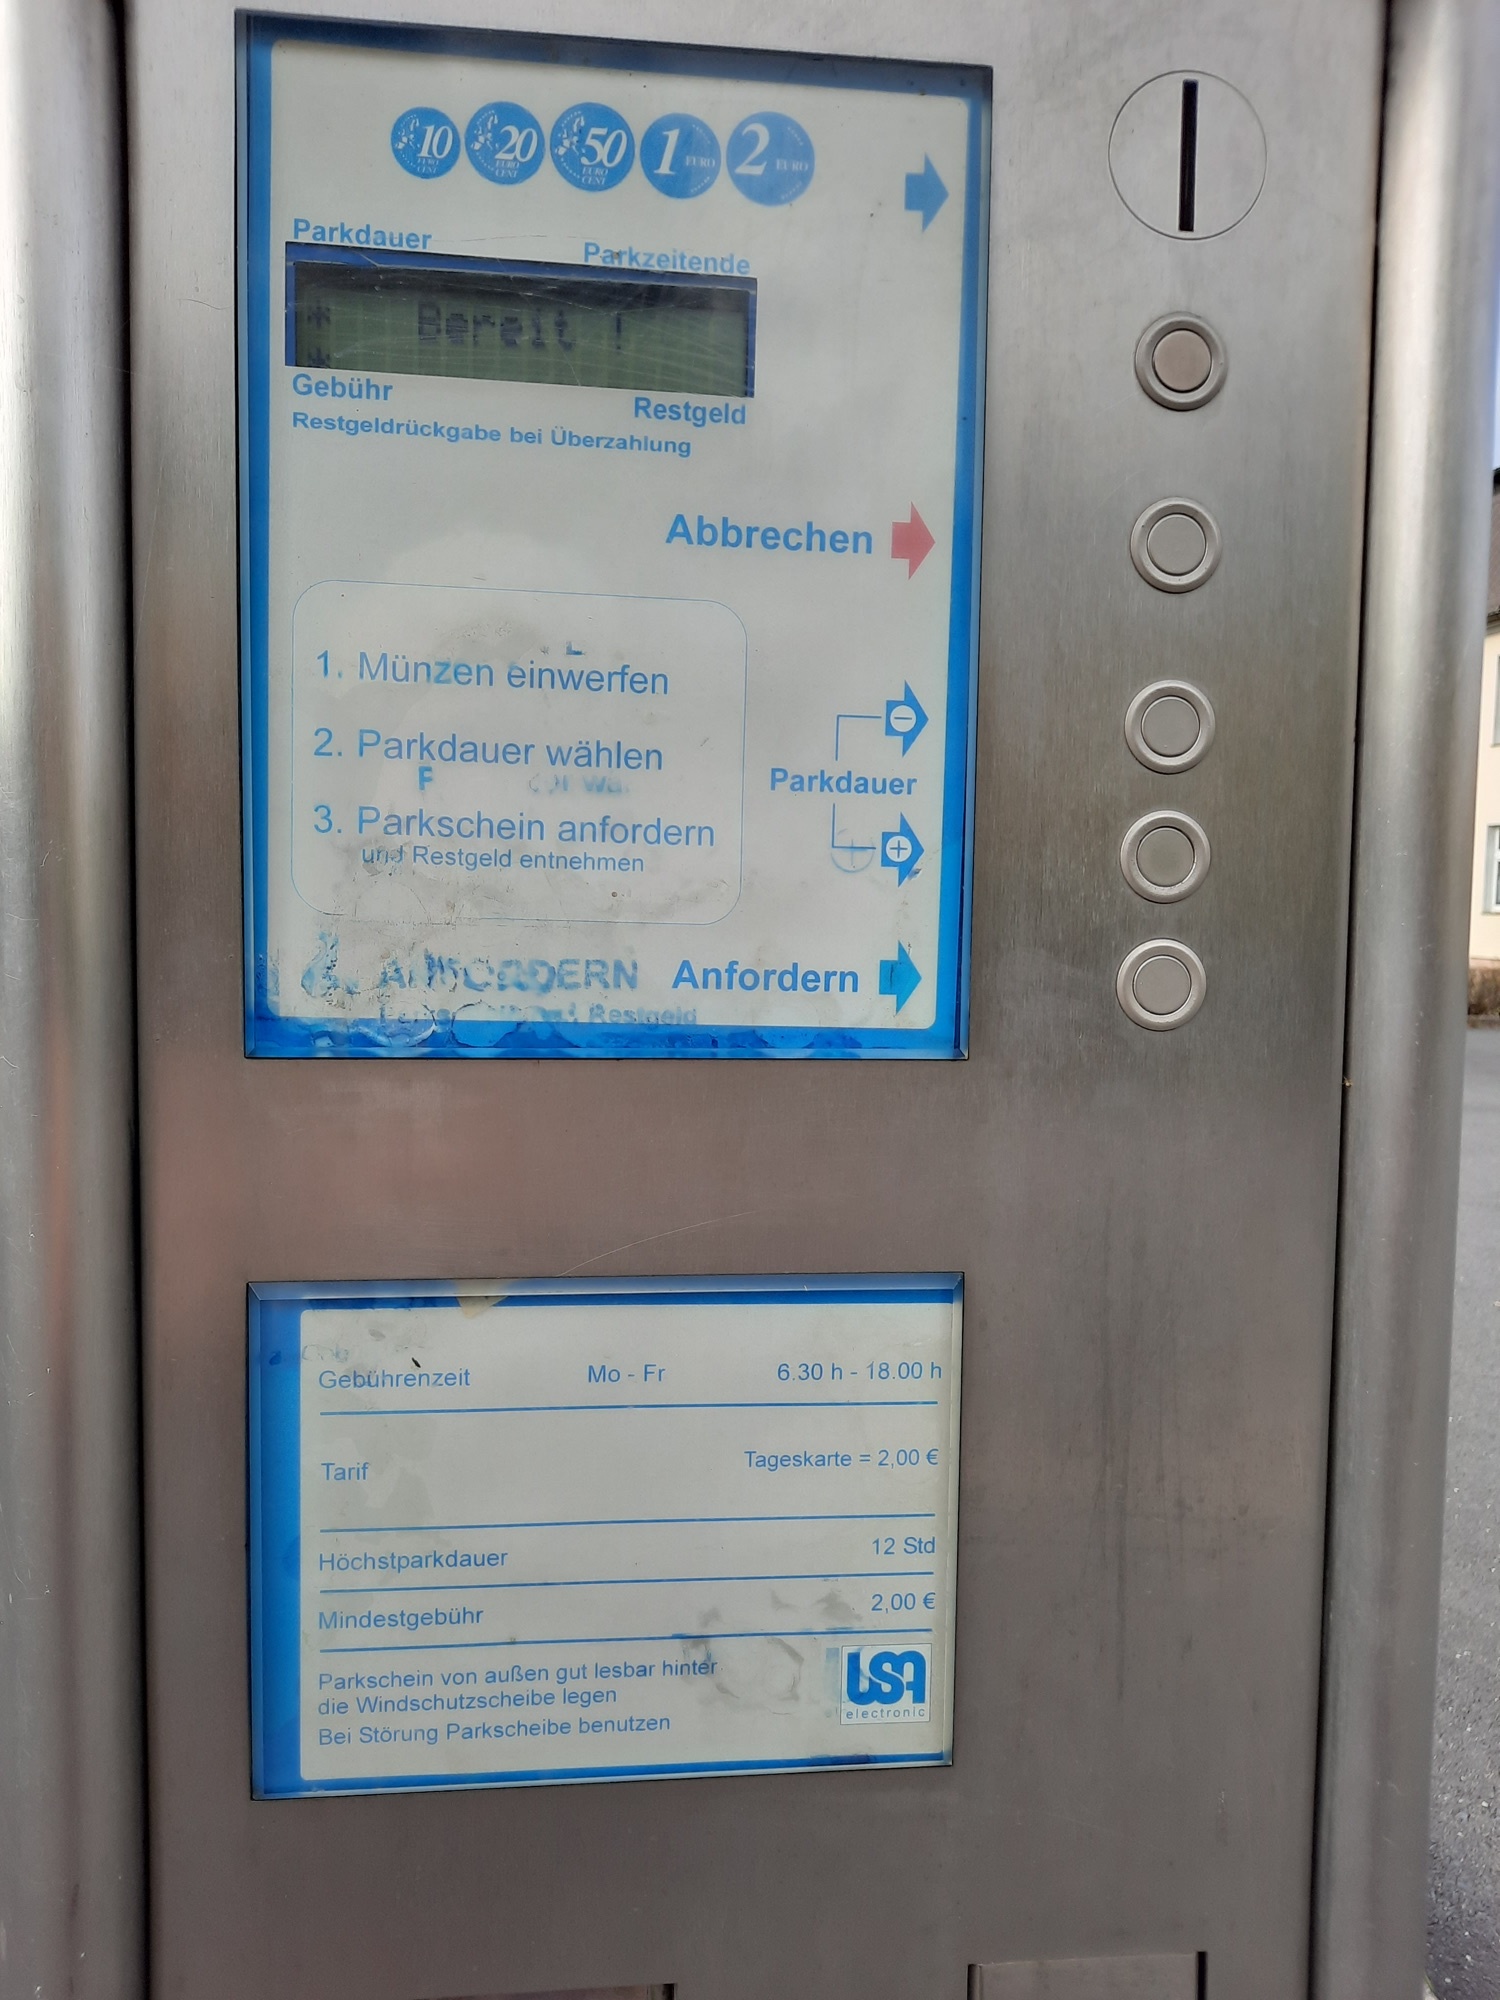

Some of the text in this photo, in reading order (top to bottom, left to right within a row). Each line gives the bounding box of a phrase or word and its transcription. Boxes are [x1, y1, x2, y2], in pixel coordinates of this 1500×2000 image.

[417, 125, 453, 158] 10
[495, 125, 538, 162] 20
[580, 127, 627, 168] 50
[654, 128, 680, 175] 1
[734, 123, 770, 176] 2
[582, 167, 608, 176] EURO
[293, 218, 432, 249] Parkdauer
[584, 242, 750, 275] Parkzeitende
[418, 301, 576, 352] Bereit
[292, 373, 393, 401] Gebühr
[634, 397, 746, 427] Restgeld
[292, 412, 691, 458] Restgeldrückgabe bei Überzahlung
[665, 514, 873, 554] Abbrechen
[317, 650, 669, 694] 1. Münzen einwerfen
[313, 728, 663, 770] 2. Parkdauer wählen
[770, 767, 917, 795] Parkdauer
[313, 804, 715, 847] 3. Parkschein anfordern
[361, 846, 645, 872] und Restgeld entnehmen
[672, 959, 859, 993] Anfordern
[319, 1368, 471, 1389] Gebührenzeit
[587, 1365, 621, 1383] Mo
[643, 1364, 666, 1382] Fr
[776, 1363, 823, 1381] 6.30
[831, 1362, 843, 1380] h
[866, 1361, 923, 1380] 18.00
[930, 1361, 942, 1379] h
[321, 1462, 369, 1481] Tarif
[744, 1450, 852, 1472] Tageskarte
[877, 1449, 920, 1469] 2,00
[926, 1448, 939, 1465] €
[872, 1536, 936, 1555] 12 Std
[319, 1550, 508, 1573] Höchstparkdauer
[871, 1591, 936, 1614] 2,00 €
[318, 1607, 484, 1631] Mindestgebühr
[319, 1659, 718, 1690] Parkschein von außen gut lesbar hinter
[318, 1687, 617, 1715] die Windschutzscheibe legen
[846, 1707, 925, 1720] electronic
[319, 1715, 671, 1745] Bei Störung Parkscheibe benutzen
